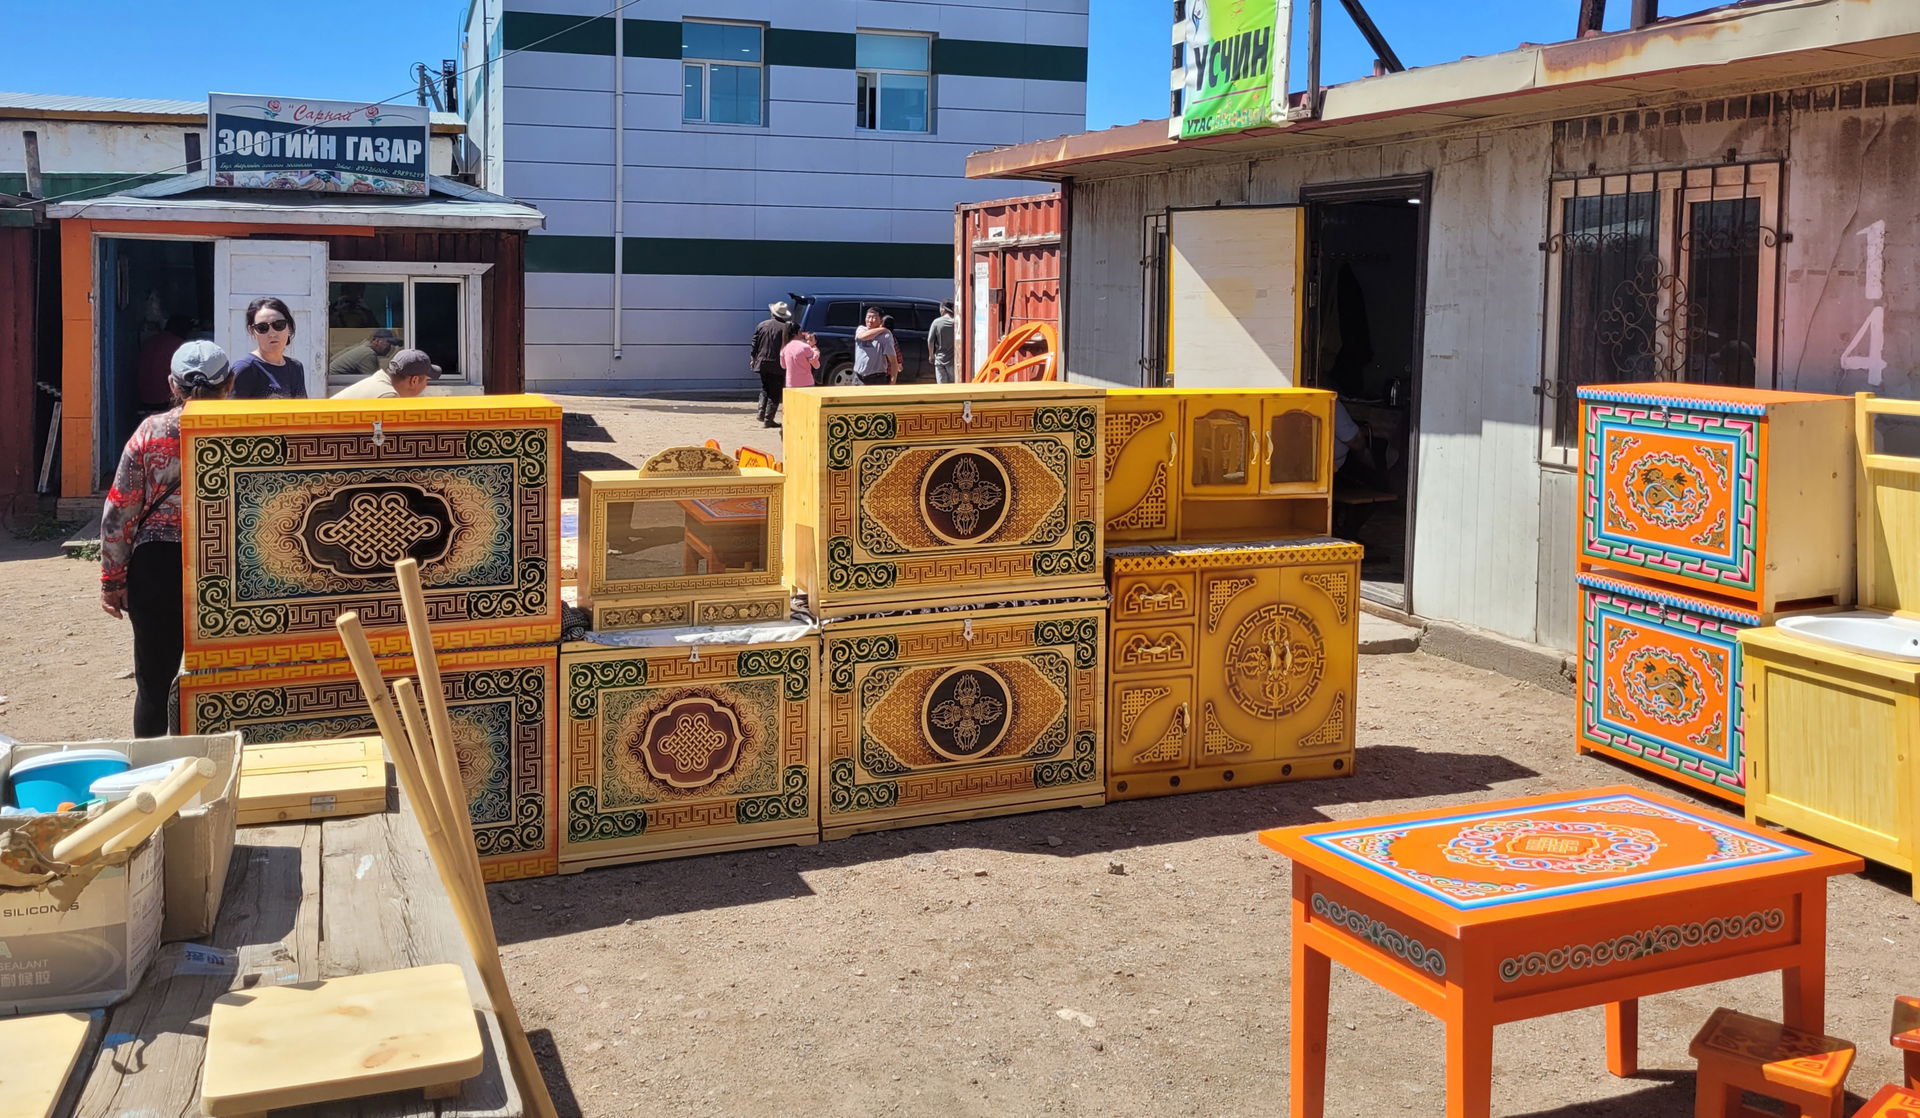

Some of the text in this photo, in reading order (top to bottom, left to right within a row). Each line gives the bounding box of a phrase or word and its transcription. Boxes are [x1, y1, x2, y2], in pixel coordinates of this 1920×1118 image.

[1193, 26, 1270, 91] УСЧИН
[1187, 116, 1212, 134] УТАС
[218, 128, 422, 164] ЗООГИЙН ГАЗАР
[3, 902, 80, 917] SILICONS
